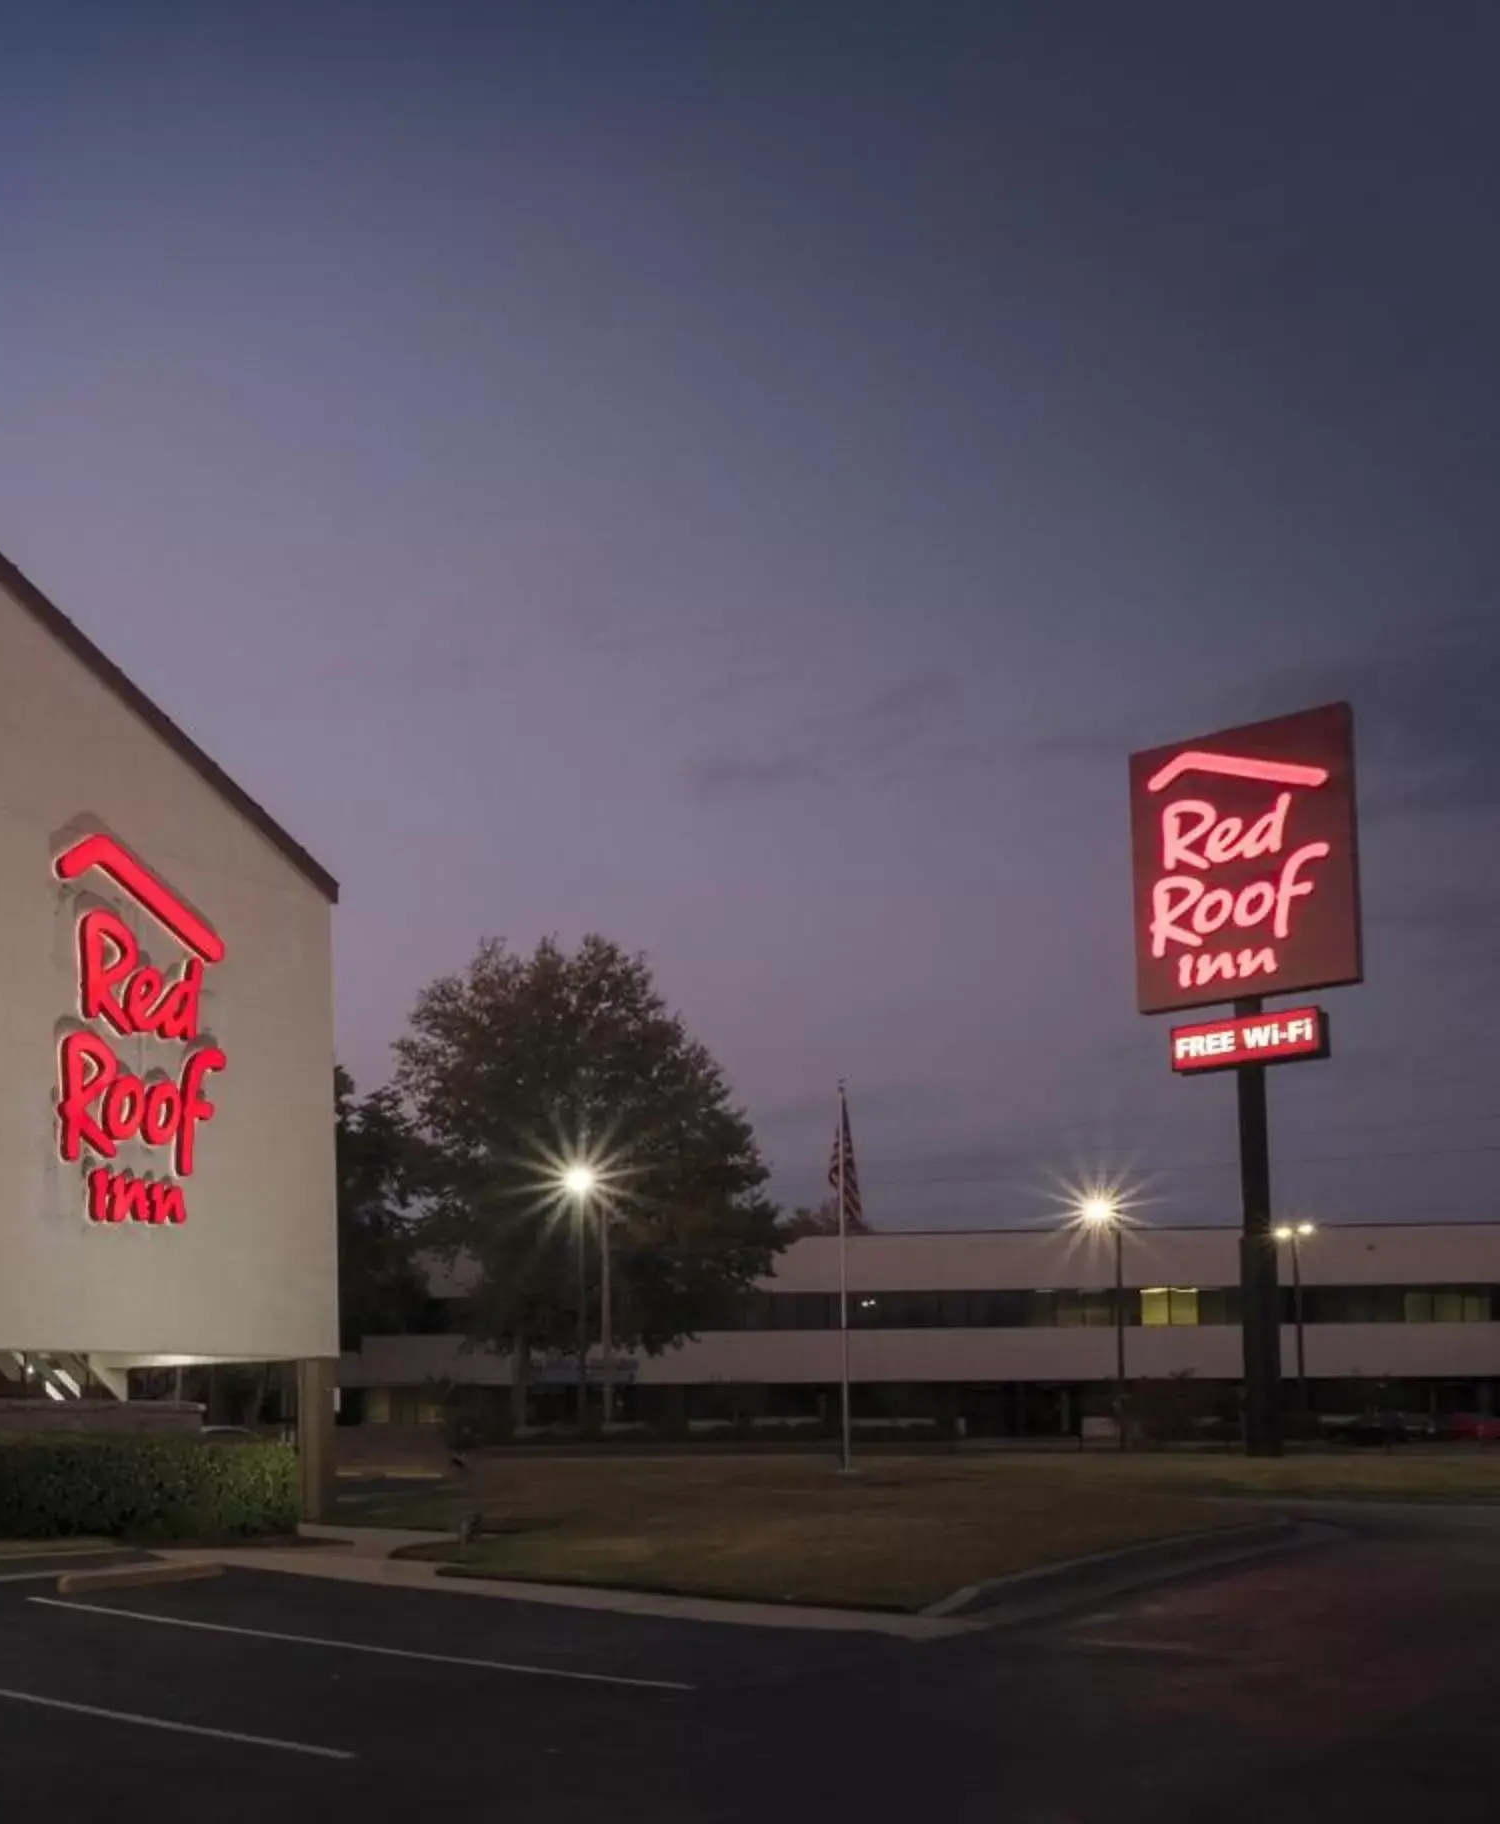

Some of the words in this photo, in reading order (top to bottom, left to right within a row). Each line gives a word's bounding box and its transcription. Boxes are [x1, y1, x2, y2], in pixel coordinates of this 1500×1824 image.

[1161, 792, 1292, 870] Red
[1150, 843, 1330, 958] Roof
[77, 908, 203, 1040] Red
[1174, 1030, 1236, 1059] FREE
[1243, 1018, 1314, 1050] Wi-Fi
[58, 1030, 227, 1177] Roof
